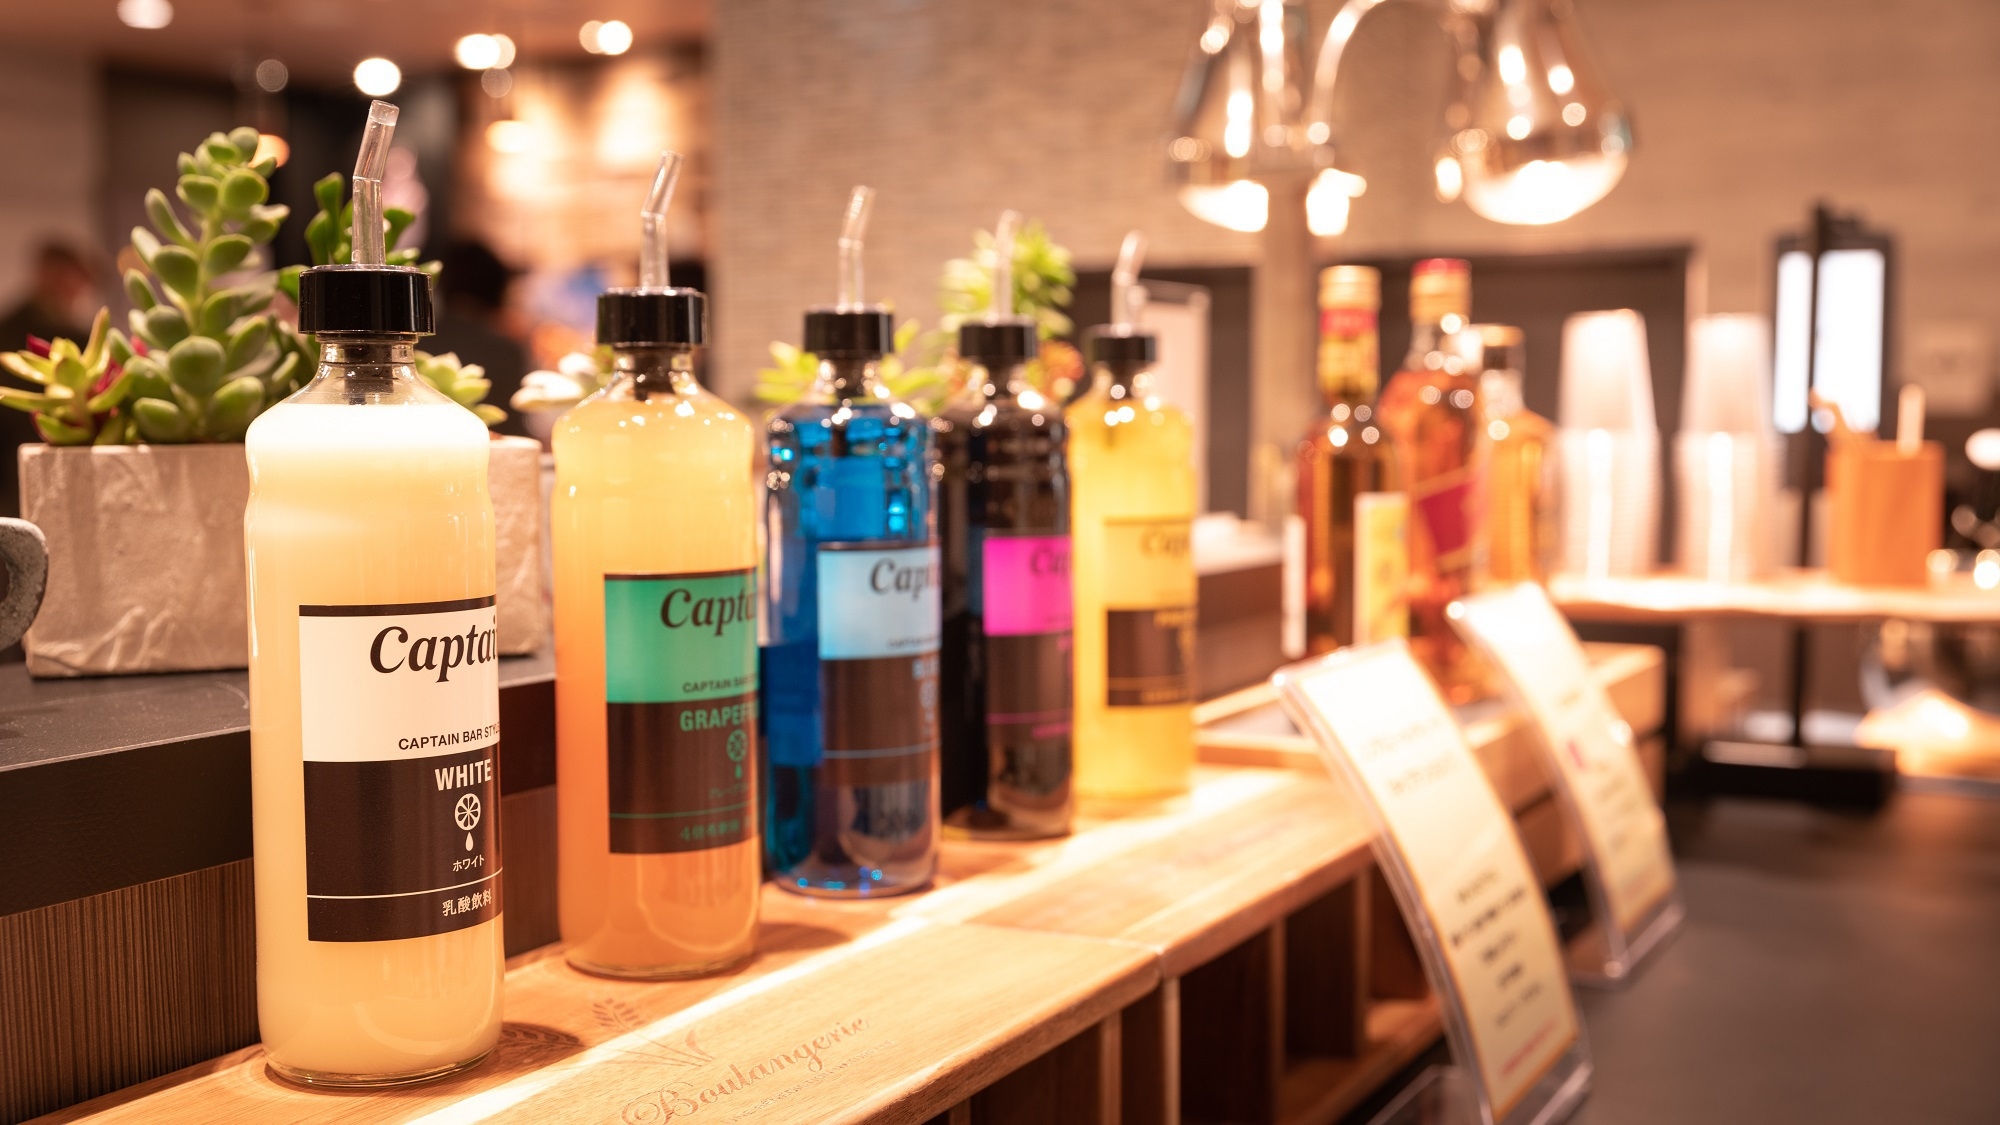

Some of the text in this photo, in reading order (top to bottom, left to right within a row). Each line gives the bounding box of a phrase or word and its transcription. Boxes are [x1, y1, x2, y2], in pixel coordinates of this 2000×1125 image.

[398, 732, 460, 750] CAPTAIN
[462, 728, 482, 743] BAR
[434, 758, 492, 791] WHITE
[452, 854, 485, 872] ホワイト
[442, 888, 492, 917] 乳酸飲料
[621, 1017, 870, 1125] Boulangerie
